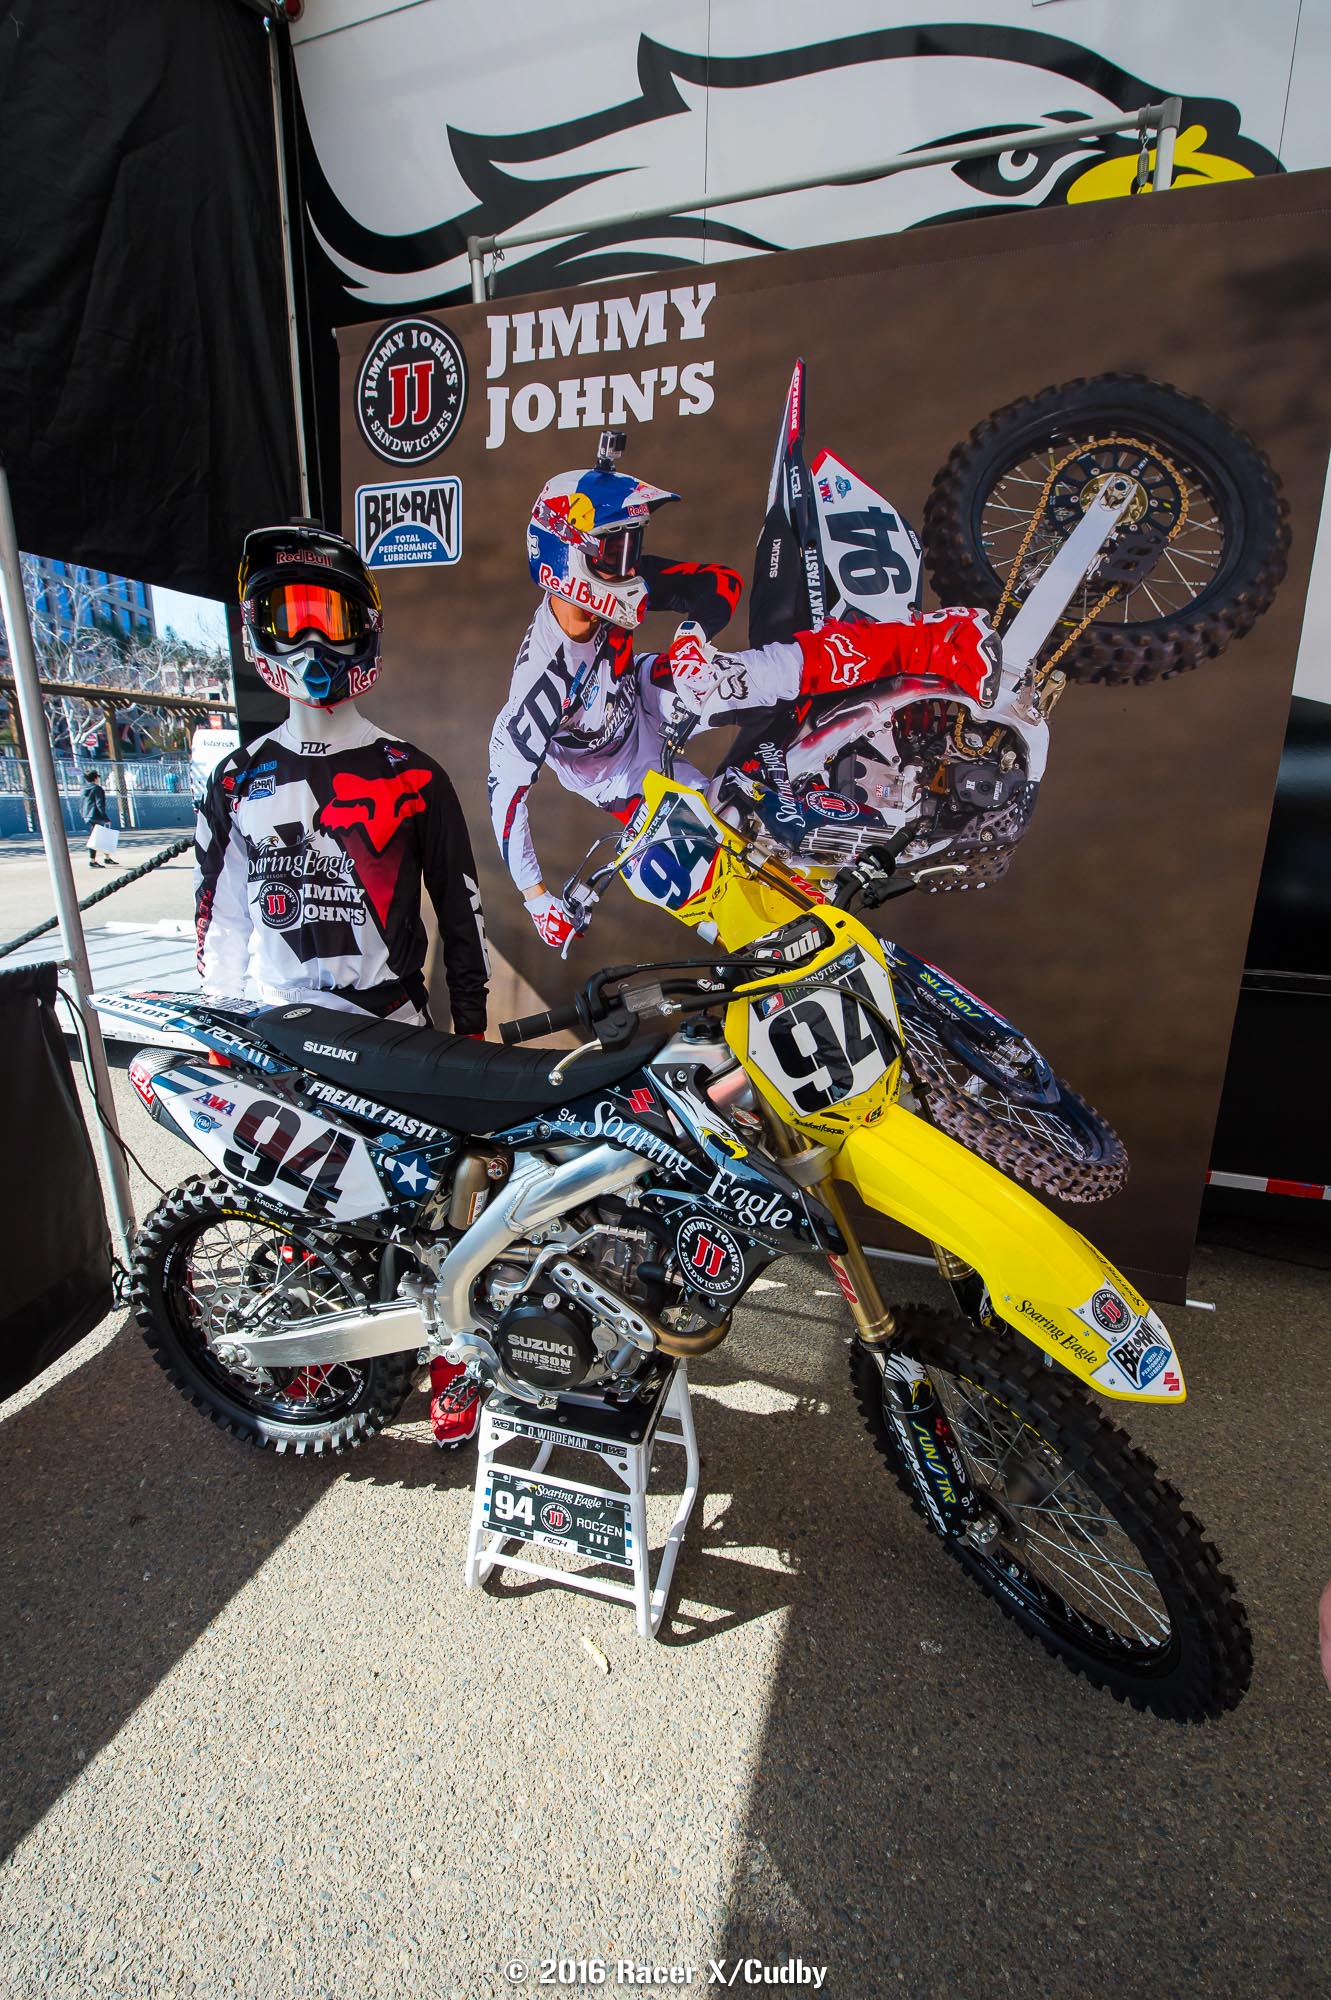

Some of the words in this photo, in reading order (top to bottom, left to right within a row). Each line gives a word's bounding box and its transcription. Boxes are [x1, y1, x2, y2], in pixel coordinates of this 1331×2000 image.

[486, 282, 717, 380] JIMMY
[365, 331, 405, 399] JIMMY
[411, 329, 458, 387] JOHN'S
[388, 360, 434, 428] JJ
[486, 360, 715, 449] JOHN'S
[371, 410, 453, 453] SANDWICHES
[817, 478, 833, 503] AMA
[379, 541, 437, 554] PERFORMANCE
[394, 534, 420, 543] TOTAL
[824, 506, 912, 596] 94
[276, 551, 303, 564] Red
[305, 551, 333, 567] Bull
[383, 551, 432, 562] LUBRICANTS
[769, 538, 781, 579] SUZUKI
[539, 563, 576, 598] Red
[575, 580, 618, 618] Bull
[257, 657, 290, 694] Bull
[300, 742, 332, 755] FOX
[248, 851, 303, 878] oaring
[303, 848, 356, 879] Eagle
[640, 797, 718, 911] 94
[267, 895, 286, 916] JJ
[298, 883, 366, 904] IMMY
[302, 904, 366, 925] OHN'S
[100, 998, 170, 1018] DUNLOP
[205, 1025, 251, 1051] RCH
[768, 967, 899, 1113] 94
[303, 1041, 358, 1063] SUZUKI
[193, 1091, 239, 1117] AMA
[306, 1081, 383, 1120] FREAKY
[380, 1108, 438, 1142] FAST!
[558, 1107, 576, 1126] 94
[223, 1099, 357, 1219] 94
[580, 1100, 693, 1182] Soaring
[706, 1163, 793, 1230] Eagle
[682, 1221, 713, 1242] JIMMY
[715, 1229, 740, 1275] JOHN'S
[692, 1233, 727, 1278] JJ
[682, 1251, 732, 1291] SANDWICHES
[1101, 1299, 1121, 1324] JJ
[1015, 1299, 1064, 1341] Soaring
[1059, 1331, 1099, 1364] Eagle
[507, 1334, 574, 1357] SUZUKI
[511, 1349, 572, 1369] HINSON
[891, 1413, 948, 1533] DUNLOP
[495, 1490, 535, 1527] 94
[536, 1485, 574, 1504] Soaring
[573, 1493, 602, 1509] Eagle
[961, 1490, 975, 1507] 94
[549, 1510, 564, 1527] JJ
[576, 1517, 623, 1538] ROCZEN
[543, 1536, 568, 1548] RCH
